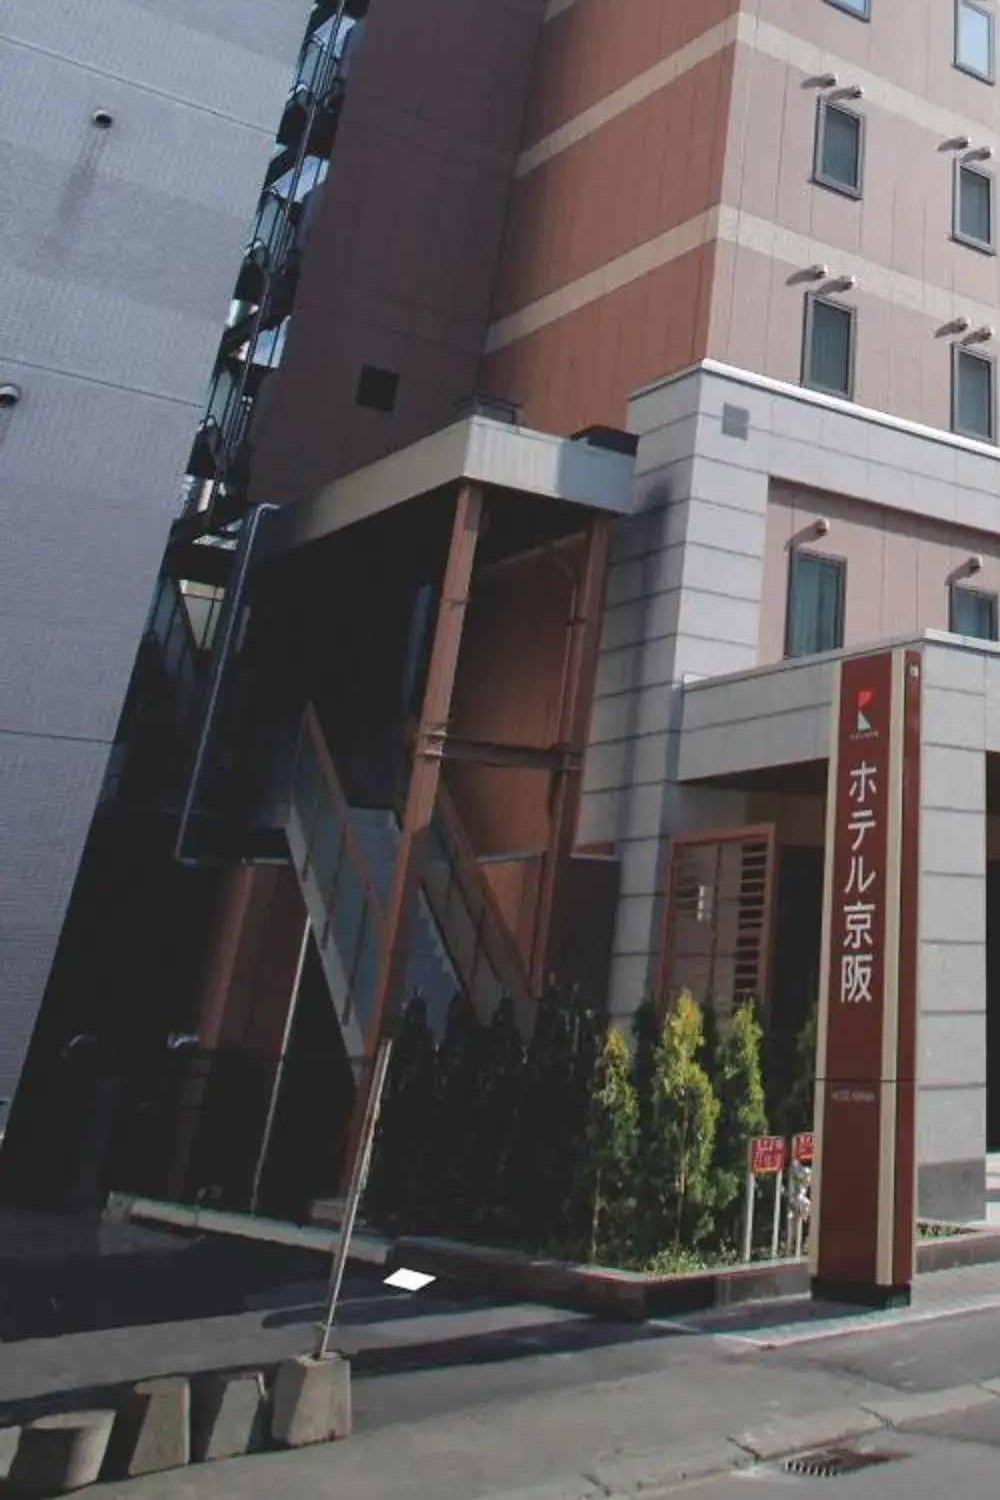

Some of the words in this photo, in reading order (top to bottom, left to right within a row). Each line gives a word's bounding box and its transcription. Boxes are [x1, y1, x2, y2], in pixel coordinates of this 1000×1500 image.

[840, 760, 877, 1003] ホテル京阪
